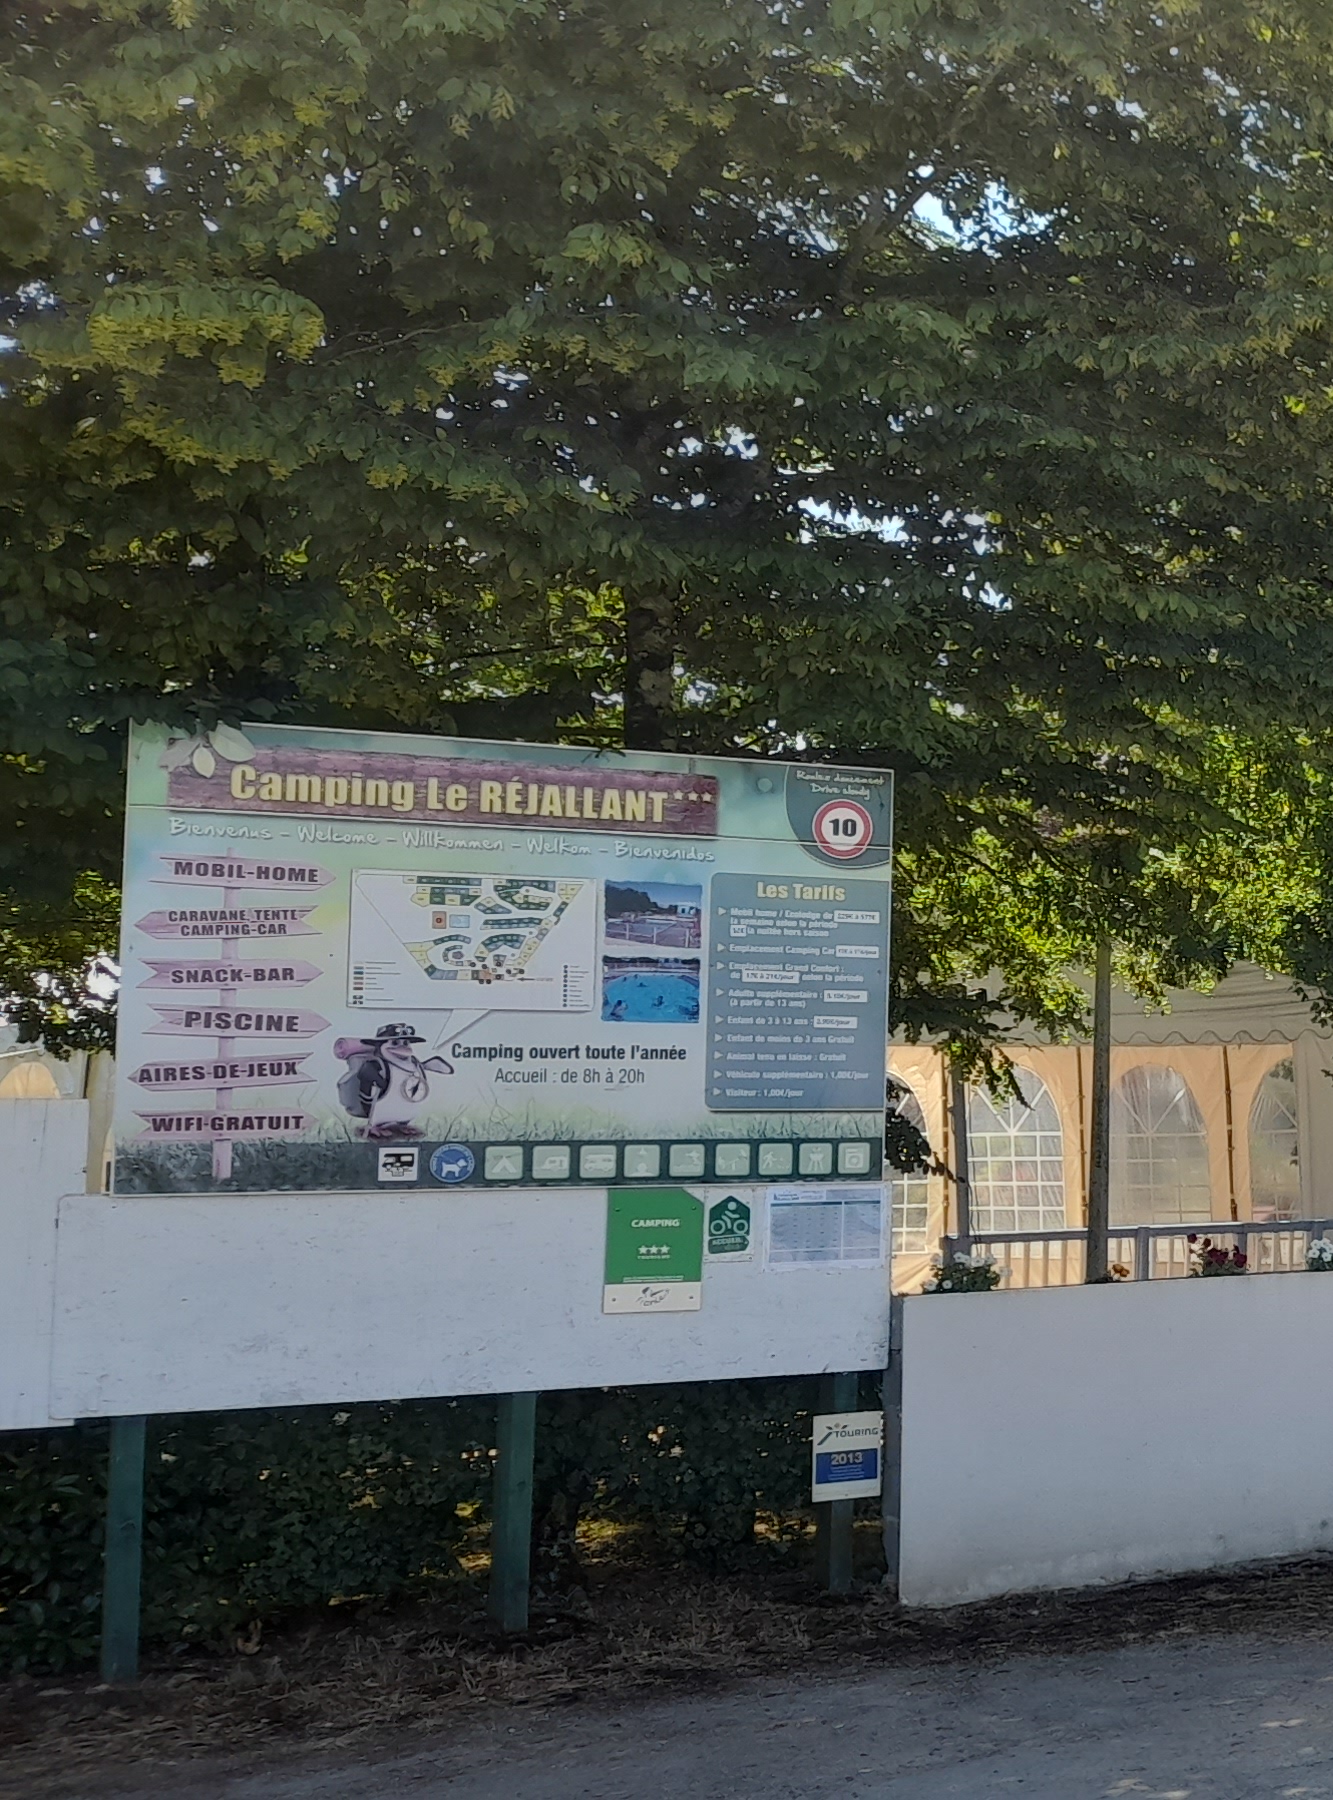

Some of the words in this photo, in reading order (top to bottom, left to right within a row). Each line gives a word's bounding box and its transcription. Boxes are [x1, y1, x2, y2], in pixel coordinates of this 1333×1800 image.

[230, 764, 414, 812] Camping
[427, 777, 468, 811] Le
[480, 776, 668, 823] RÉJALLANT
[810, 783, 840, 794] Drive
[829, 818, 857, 837] 10
[169, 816, 272, 840] Bienvenus
[298, 823, 379, 844] Welcome
[402, 827, 504, 850] Willkommen
[526, 838, 592, 855] Welkom
[614, 841, 715, 862] Bienvenidos
[174, 861, 319, 882] MOBIL-HOME
[757, 881, 788, 899] Les
[793, 883, 846, 901] Tarifs
[254, 909, 298, 921] TENTE
[180, 924, 288, 936] CAMPING-CAR
[171, 967, 295, 983] SNACK-BAR
[184, 1011, 300, 1032] PISCINE
[451, 1043, 523, 1062] Camping
[529, 1044, 580, 1059] ouvert
[585, 1045, 625, 1060] toute
[631, 1045, 687, 1060] l'année
[138, 1062, 298, 1082] AIRES-DE-JEUX
[495, 1068, 547, 1083] Accueil
[561, 1068, 578, 1083] de
[583, 1068, 600, 1083] 8h
[605, 1068, 614, 1083] à
[619, 1068, 644, 1083] 20h
[151, 1116, 304, 1132] WIFI-GRATUIT
[631, 1219, 680, 1227] CAMPING
[833, 1427, 879, 1438] TOURING
[831, 1452, 863, 1465] 2013
